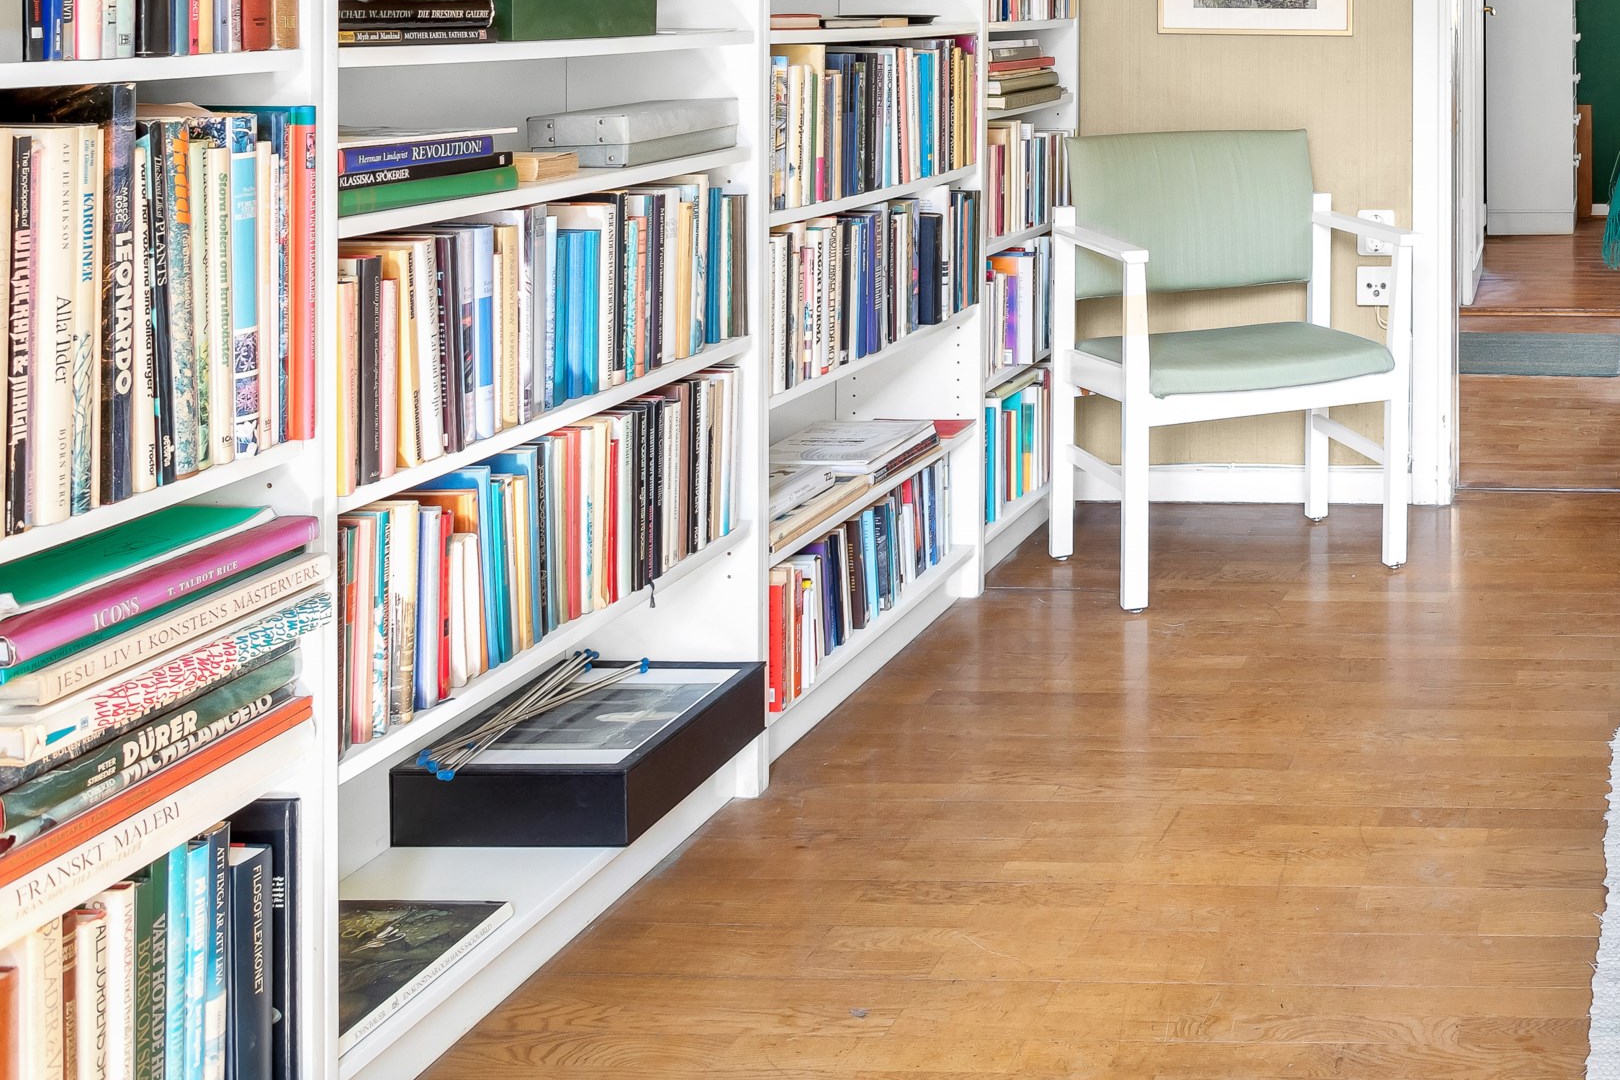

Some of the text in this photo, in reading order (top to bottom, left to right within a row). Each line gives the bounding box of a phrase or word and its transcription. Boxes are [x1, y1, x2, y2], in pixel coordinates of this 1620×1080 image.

[356, 31, 400, 41] Myth and Mankind
[404, 31, 428, 40] MOTHER
[449, 30, 467, 39] FATHER
[468, 30, 478, 38] SKY
[417, 9, 490, 18] DIE DRESDNER GALERIE
[20, 150, 30, 215] The Encyclopedia
[339, 169, 410, 187] KLASSISKA SPÖKERIER
[358, 140, 483, 164] Herman Lindqvist REVOLUTION!
[61, 142, 70, 250] ALF HENRIKSON
[81, 192, 96, 283] KAROLINER
[155, 221, 168, 287] PLANTS
[218, 172, 232, 368] Stora boken om krukväxter
[54, 295, 72, 385] Alla Tider
[114, 232, 132, 395] LEONARDO
[58, 429, 67, 507] BJÖRN BERG
[179, 560, 239, 591] TALBOT RICE
[56, 563, 321, 694] JESU LIV KONSTENS MÄSTERVERK
[92, 596, 140, 631] ICONS
[122, 709, 199, 766] DÜRER
[15, 801, 180, 908] FRANSKT MALERI
[215, 847, 225, 986] ATT FLYGA ÄR ATT LEVA
[252, 864, 263, 996] FILOSOFILEXIKONET
[137, 938, 151, 1045] BOKEN OM
[152, 975, 166, 1046] HOTADE
